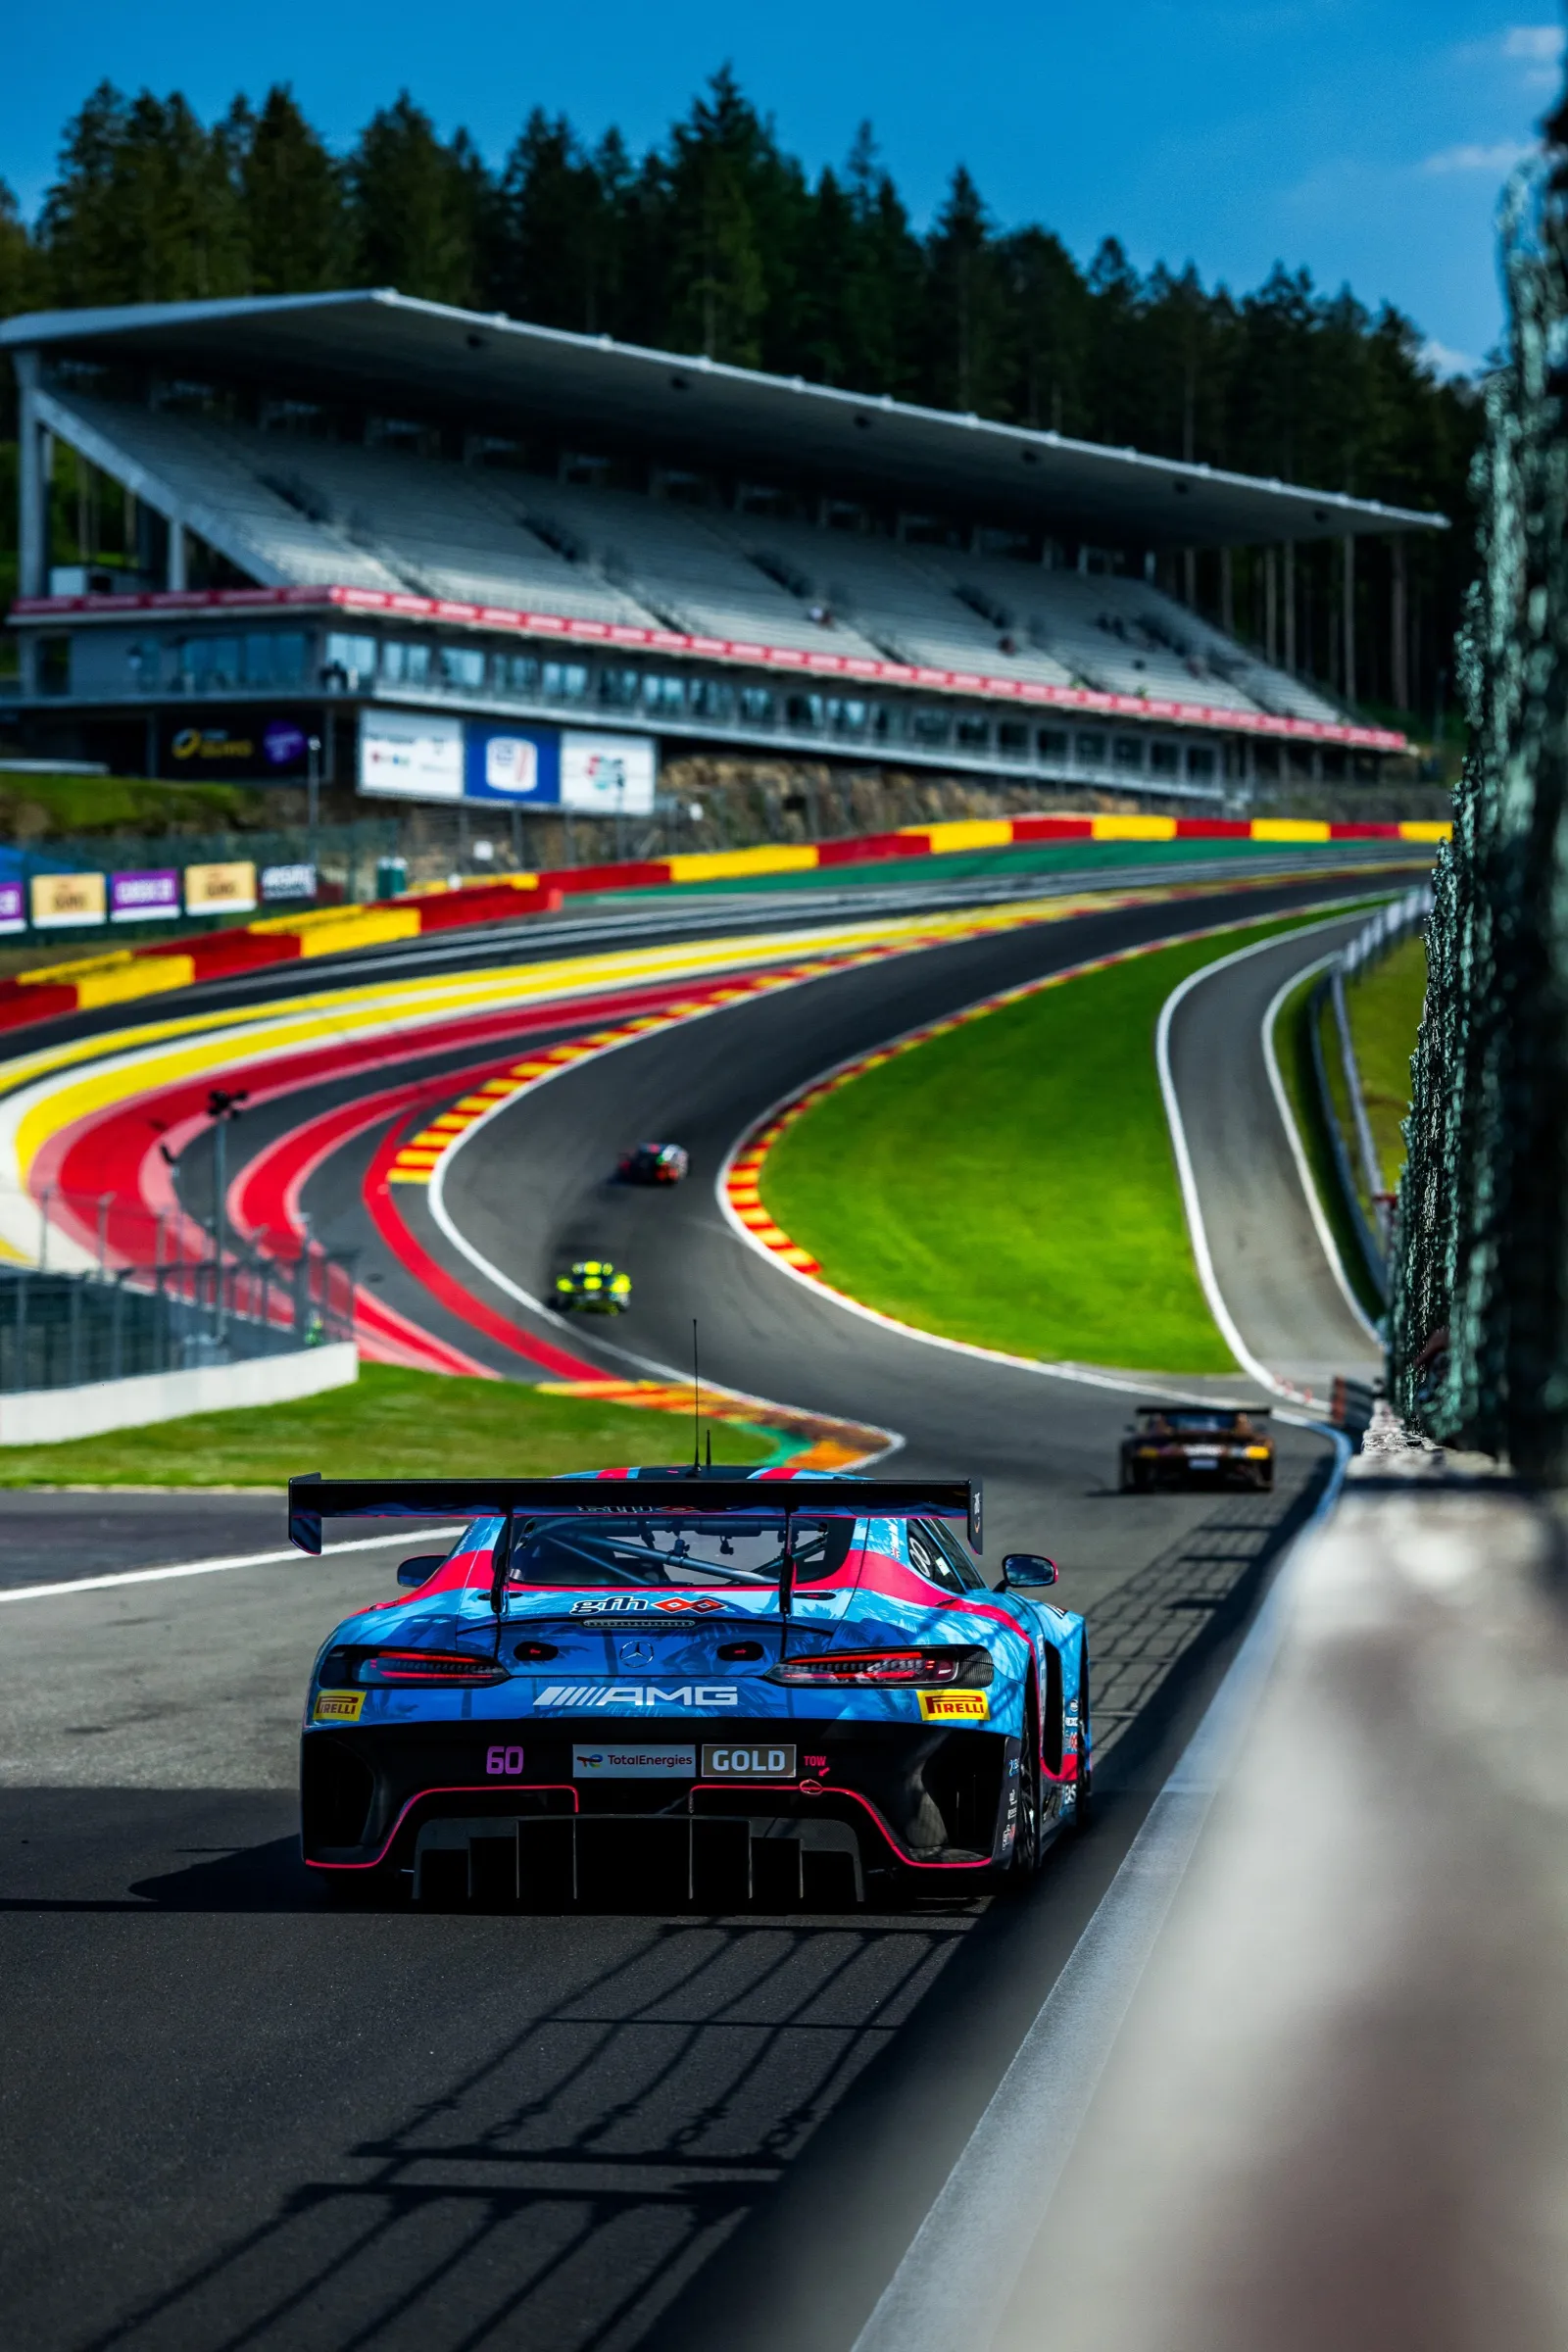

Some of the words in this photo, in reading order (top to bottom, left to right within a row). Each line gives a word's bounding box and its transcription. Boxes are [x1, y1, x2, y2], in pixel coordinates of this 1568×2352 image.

[570, 1596, 648, 1615] gfh
[317, 1695, 359, 1714] PIRELLI
[594, 1687, 738, 1706] AMG
[925, 1695, 984, 1714] PIRELLI
[486, 1745, 523, 1775] 60
[607, 1753, 693, 1767] TotalEnergies
[711, 1749, 786, 1772] GOLD
[804, 1755, 826, 1766] TOW
